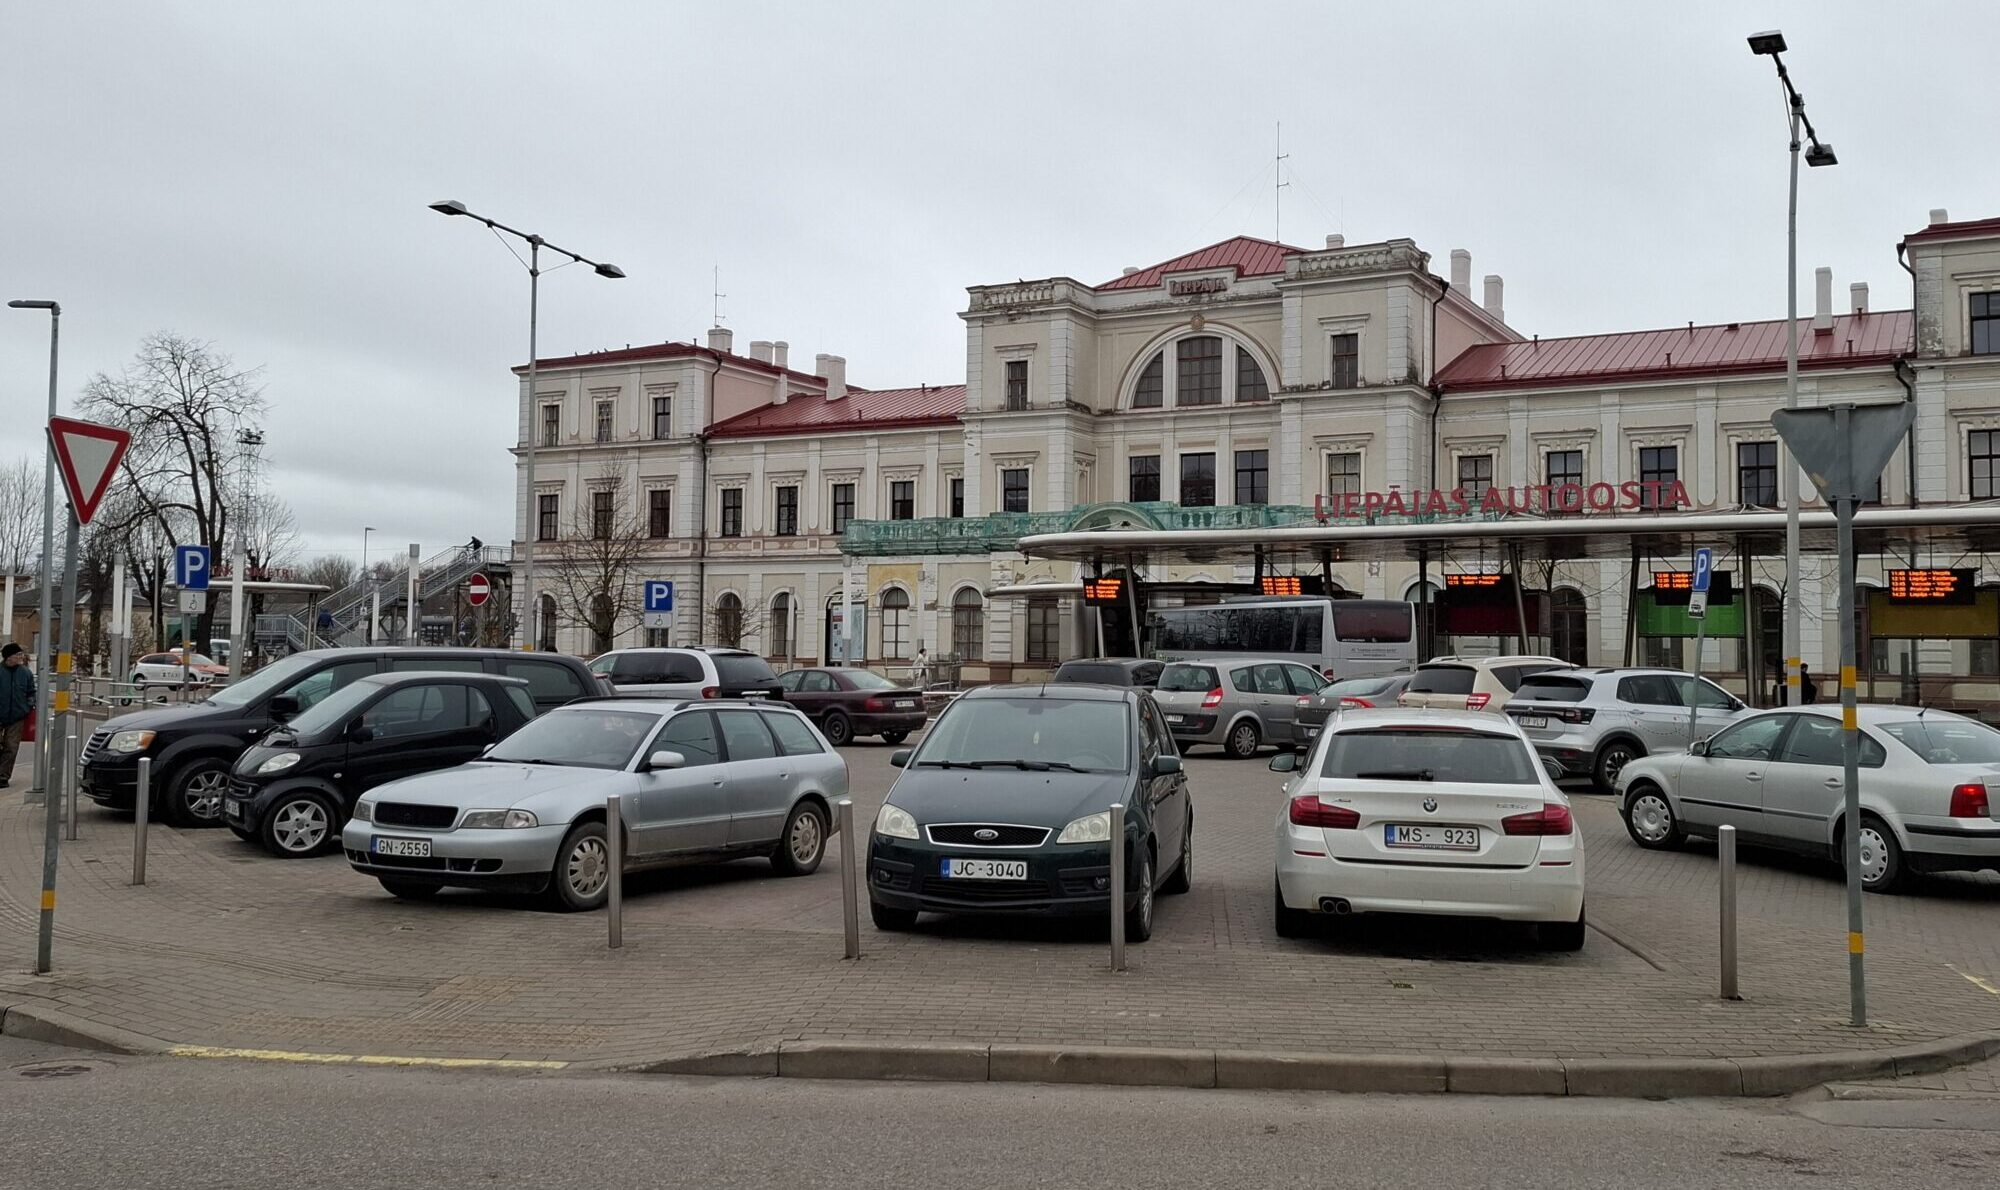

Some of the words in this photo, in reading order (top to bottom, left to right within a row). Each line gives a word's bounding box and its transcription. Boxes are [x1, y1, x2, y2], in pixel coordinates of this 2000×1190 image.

[1315, 485, 1470, 519] LIEPĀJAS
[1480, 480, 1692, 514] AUTOOSTA
[185, 550, 205, 585] P
[1695, 553, 1707, 586] P
[652, 584, 669, 608] P
[379, 839, 429, 856] GN-2559
